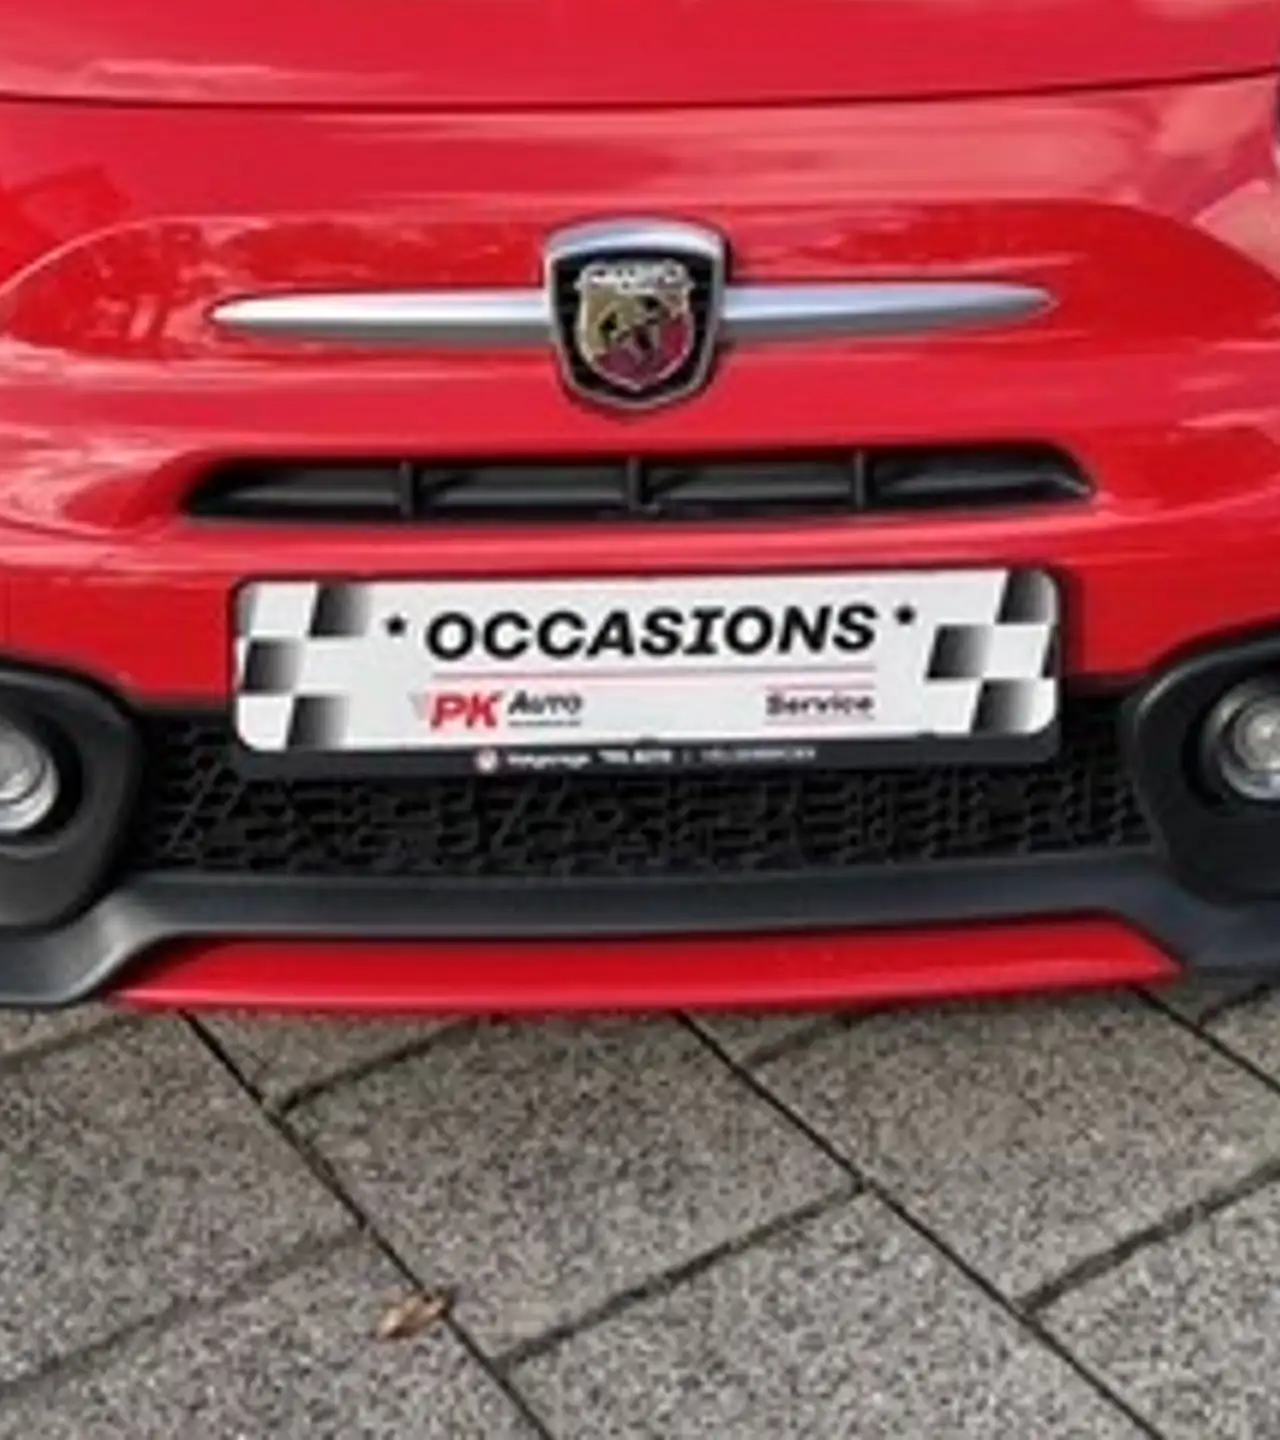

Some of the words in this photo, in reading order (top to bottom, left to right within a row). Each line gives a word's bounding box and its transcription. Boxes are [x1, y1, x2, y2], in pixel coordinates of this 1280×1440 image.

[425, 603, 878, 661] OCCASIONS
[430, 691, 499, 730] PK
[765, 692, 875, 716] Service
